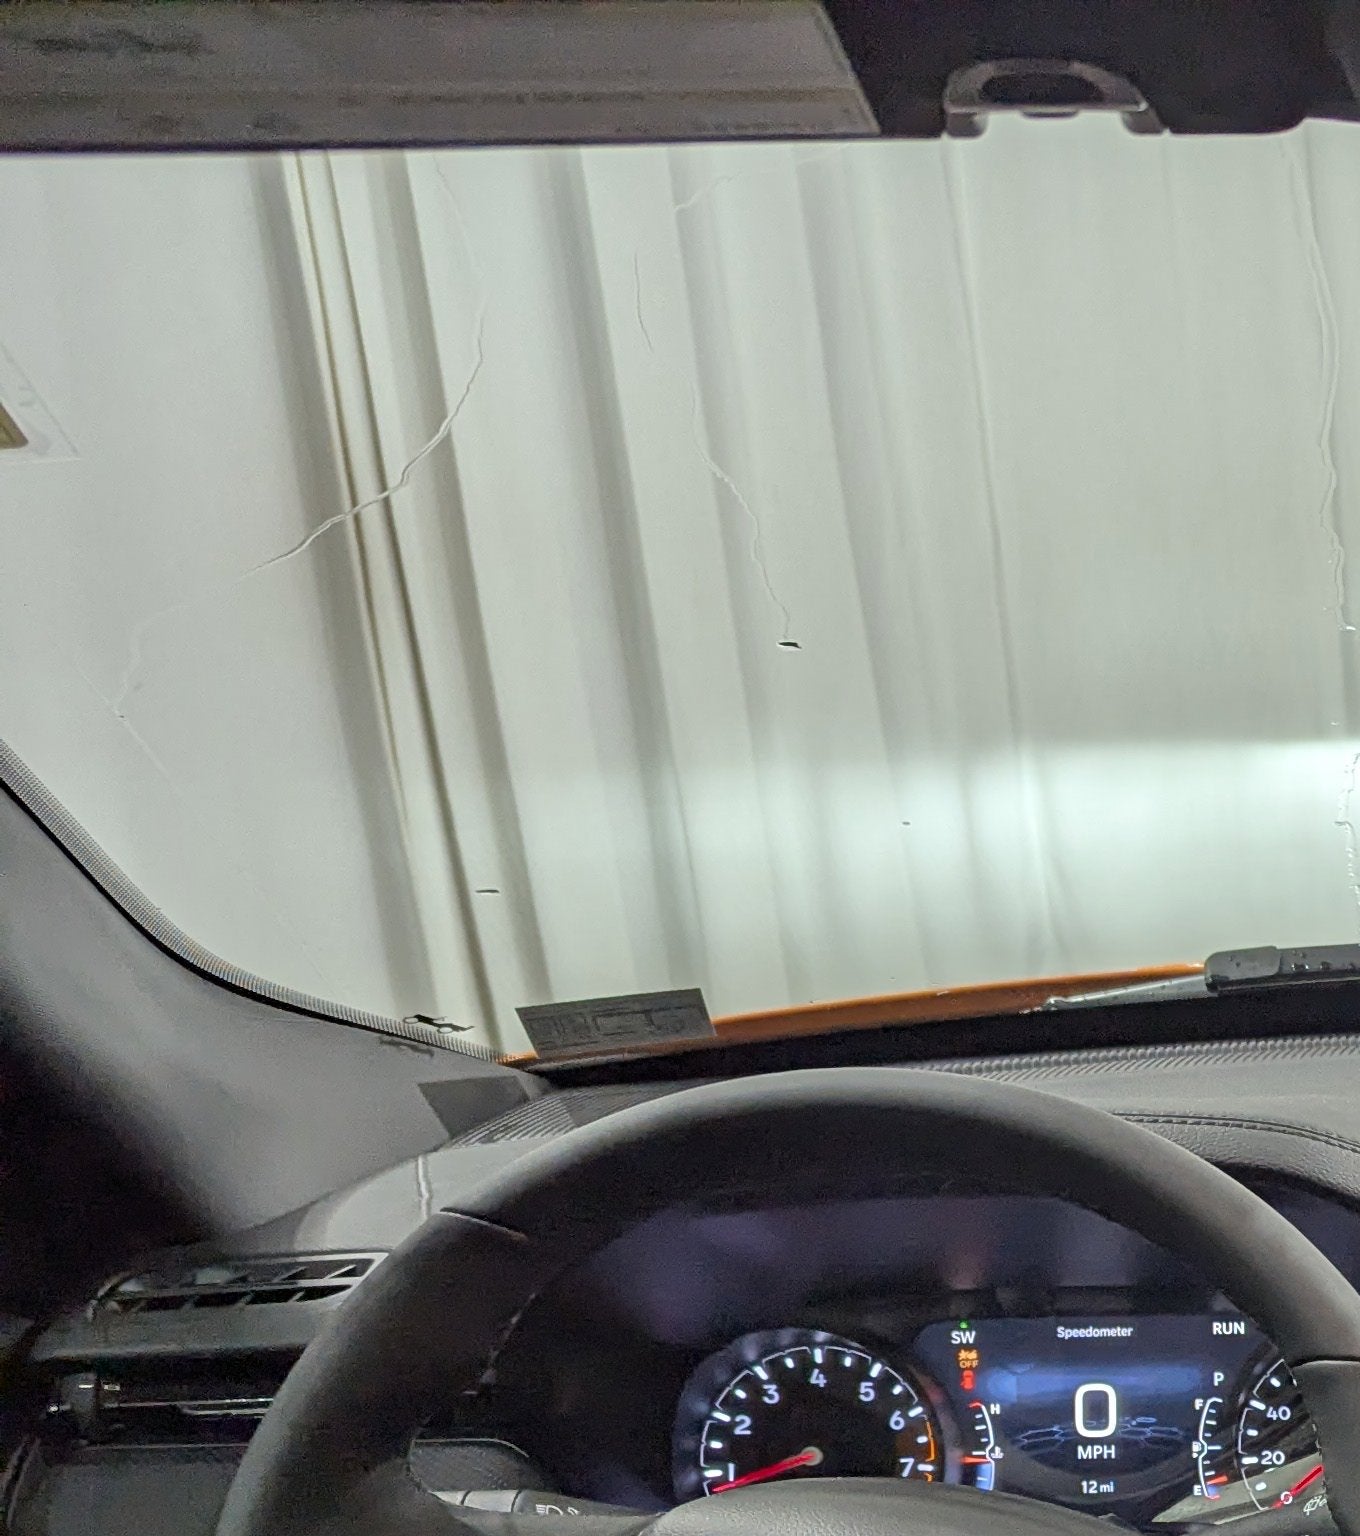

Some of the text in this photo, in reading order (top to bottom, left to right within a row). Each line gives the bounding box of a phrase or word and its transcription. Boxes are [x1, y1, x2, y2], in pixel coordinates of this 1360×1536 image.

[1056, 1326, 1134, 1341] Speedometer
[1212, 1321, 1245, 1335] RUN
[951, 1330, 976, 1345] SW
[809, 1368, 827, 1388] 4
[1213, 1372, 1224, 1386] P
[762, 1384, 780, 1404] 3
[859, 1382, 875, 1402] 5
[990, 1403, 1000, 1415] H
[1074, 1383, 1117, 1438] 0
[1194, 1398, 1203, 1411] F
[889, 1410, 905, 1431] 6
[1266, 1405, 1292, 1421] 40
[733, 1414, 752, 1436] 2
[1077, 1445, 1116, 1460] MPH
[1260, 1450, 1286, 1466] 20
[727, 1463, 736, 1482] 1
[899, 1458, 915, 1478] 7
[1081, 1480, 1115, 1494] 12 mi
[1193, 1484, 1202, 1496] E
